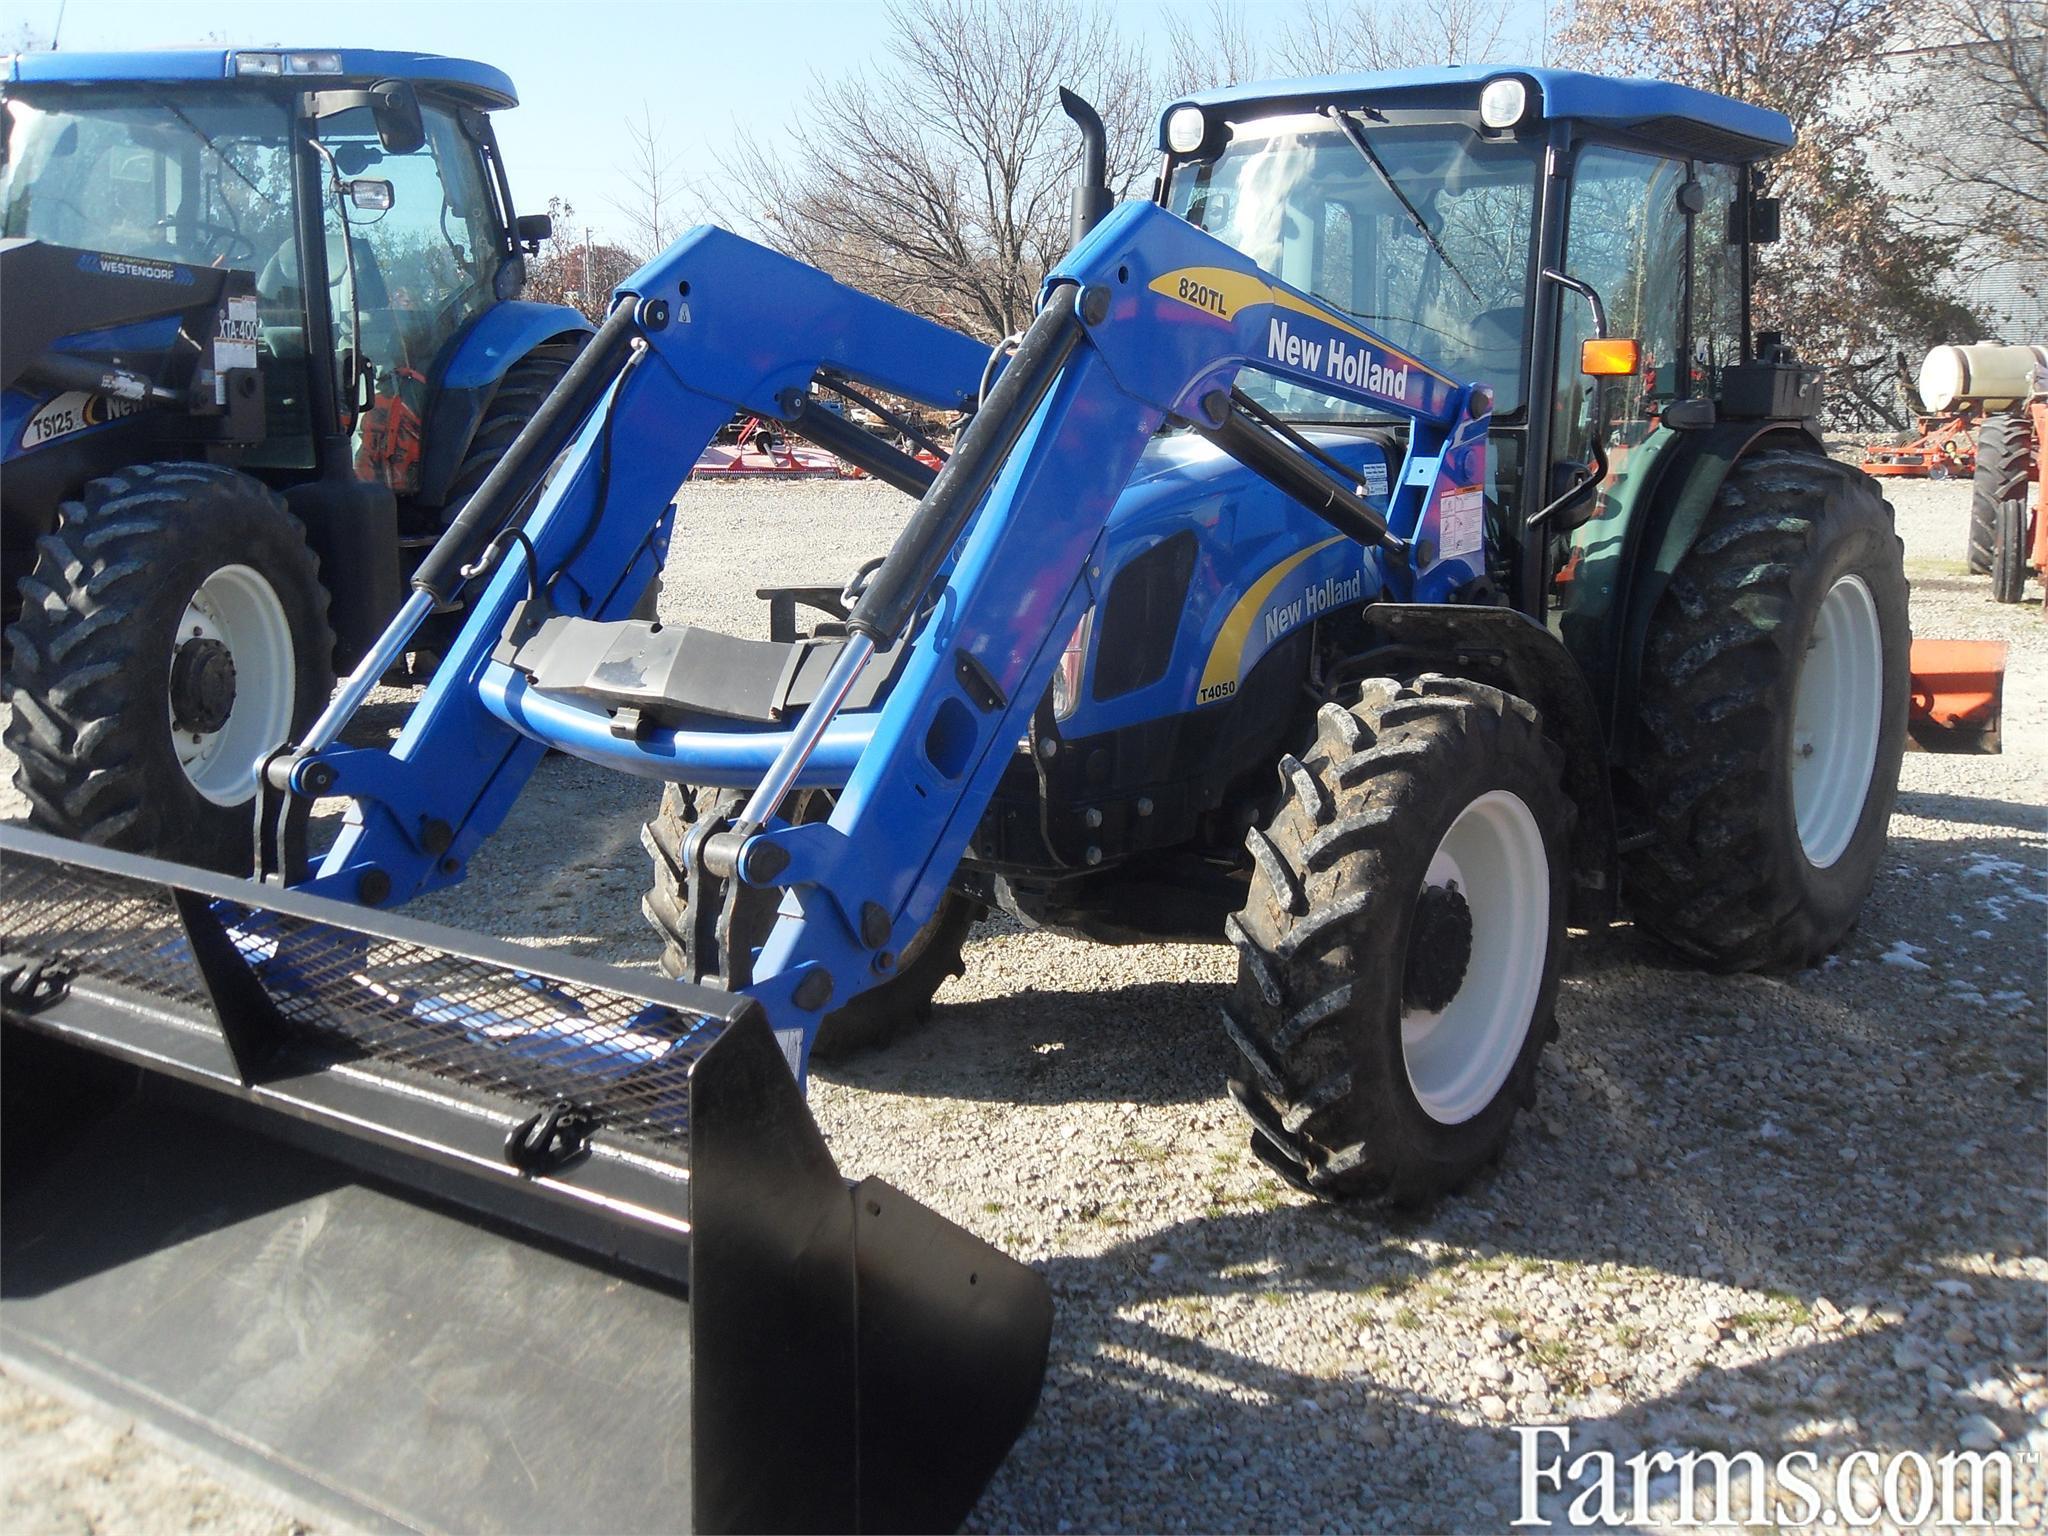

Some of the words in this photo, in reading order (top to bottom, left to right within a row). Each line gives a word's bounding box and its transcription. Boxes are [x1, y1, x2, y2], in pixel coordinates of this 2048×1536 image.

[100, 260, 174, 280] WESTENDORF
[1179, 277, 1227, 315] 820TL
[1268, 318, 1322, 371] New
[1327, 338, 1408, 400] Holland
[1265, 599, 1302, 644] New
[1305, 570, 1361, 616] Holland
[1200, 681, 1236, 701] T4050
